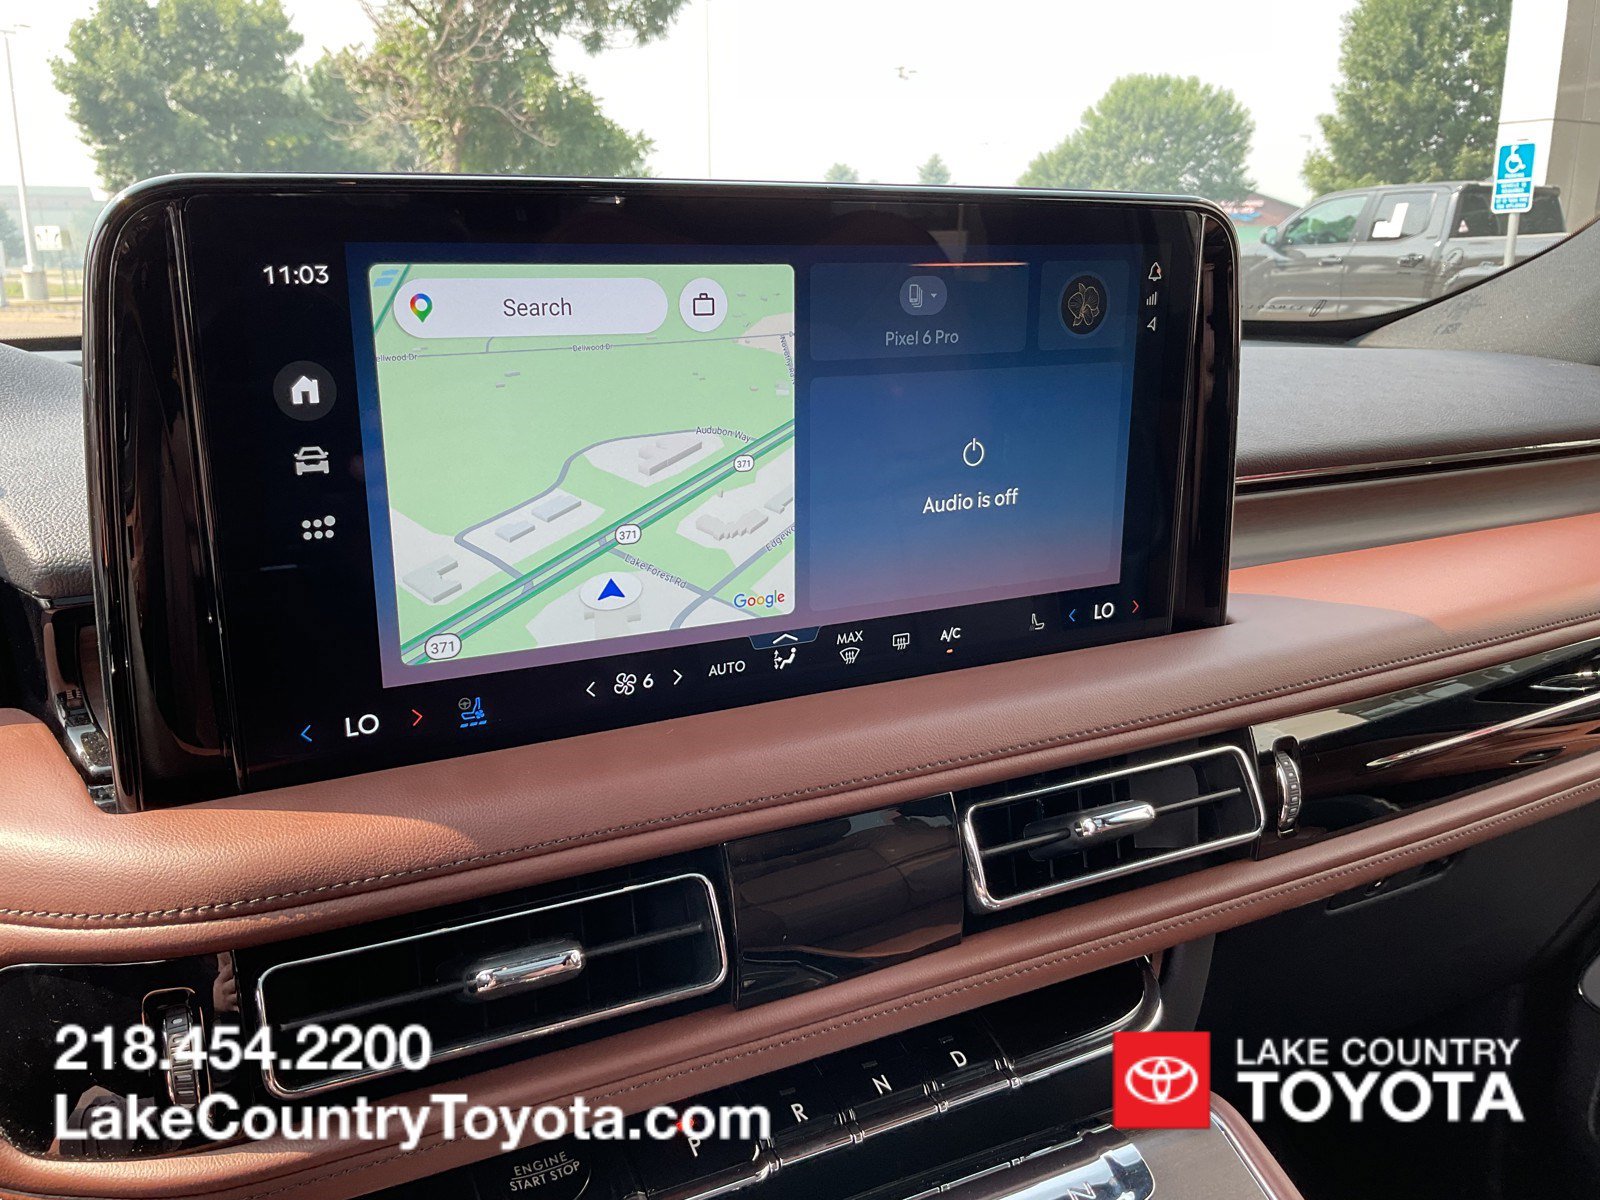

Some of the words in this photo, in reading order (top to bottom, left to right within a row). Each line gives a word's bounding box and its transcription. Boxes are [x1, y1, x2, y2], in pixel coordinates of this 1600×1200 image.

[263, 265, 329, 284] 11:03
[503, 297, 572, 317] Search
[885, 331, 919, 346] Pixel
[922, 331, 931, 345] 6
[935, 330, 959, 344] Pro
[408, 353, 417, 361] Dr
[695, 426, 733, 437] Audubon
[734, 430, 751, 444] Way
[736, 459, 751, 469] 371
[922, 494, 973, 514] Audio
[977, 492, 990, 508] is
[994, 488, 1019, 506] off
[619, 529, 637, 541] 371
[624, 553, 646, 570] Lake
[646, 563, 674, 582] Forest
[674, 577, 687, 589] Rd
[733, 589, 785, 608] Google
[1093, 602, 1114, 620] LO
[836, 630, 864, 645] MAX
[940, 627, 961, 642] A/C
[430, 641, 455, 655] 371
[708, 660, 746, 677] AUTO
[642, 674, 654, 689] 6
[345, 713, 380, 737] LO
[950, 1051, 967, 1067] D
[872, 1074, 892, 1095] N
[790, 1103, 809, 1122] R
[687, 1137, 700, 1157] P
[514, 1151, 568, 1177] ENGINE
[509, 1173, 547, 1191] START
[550, 1160, 581, 1181] STOP
